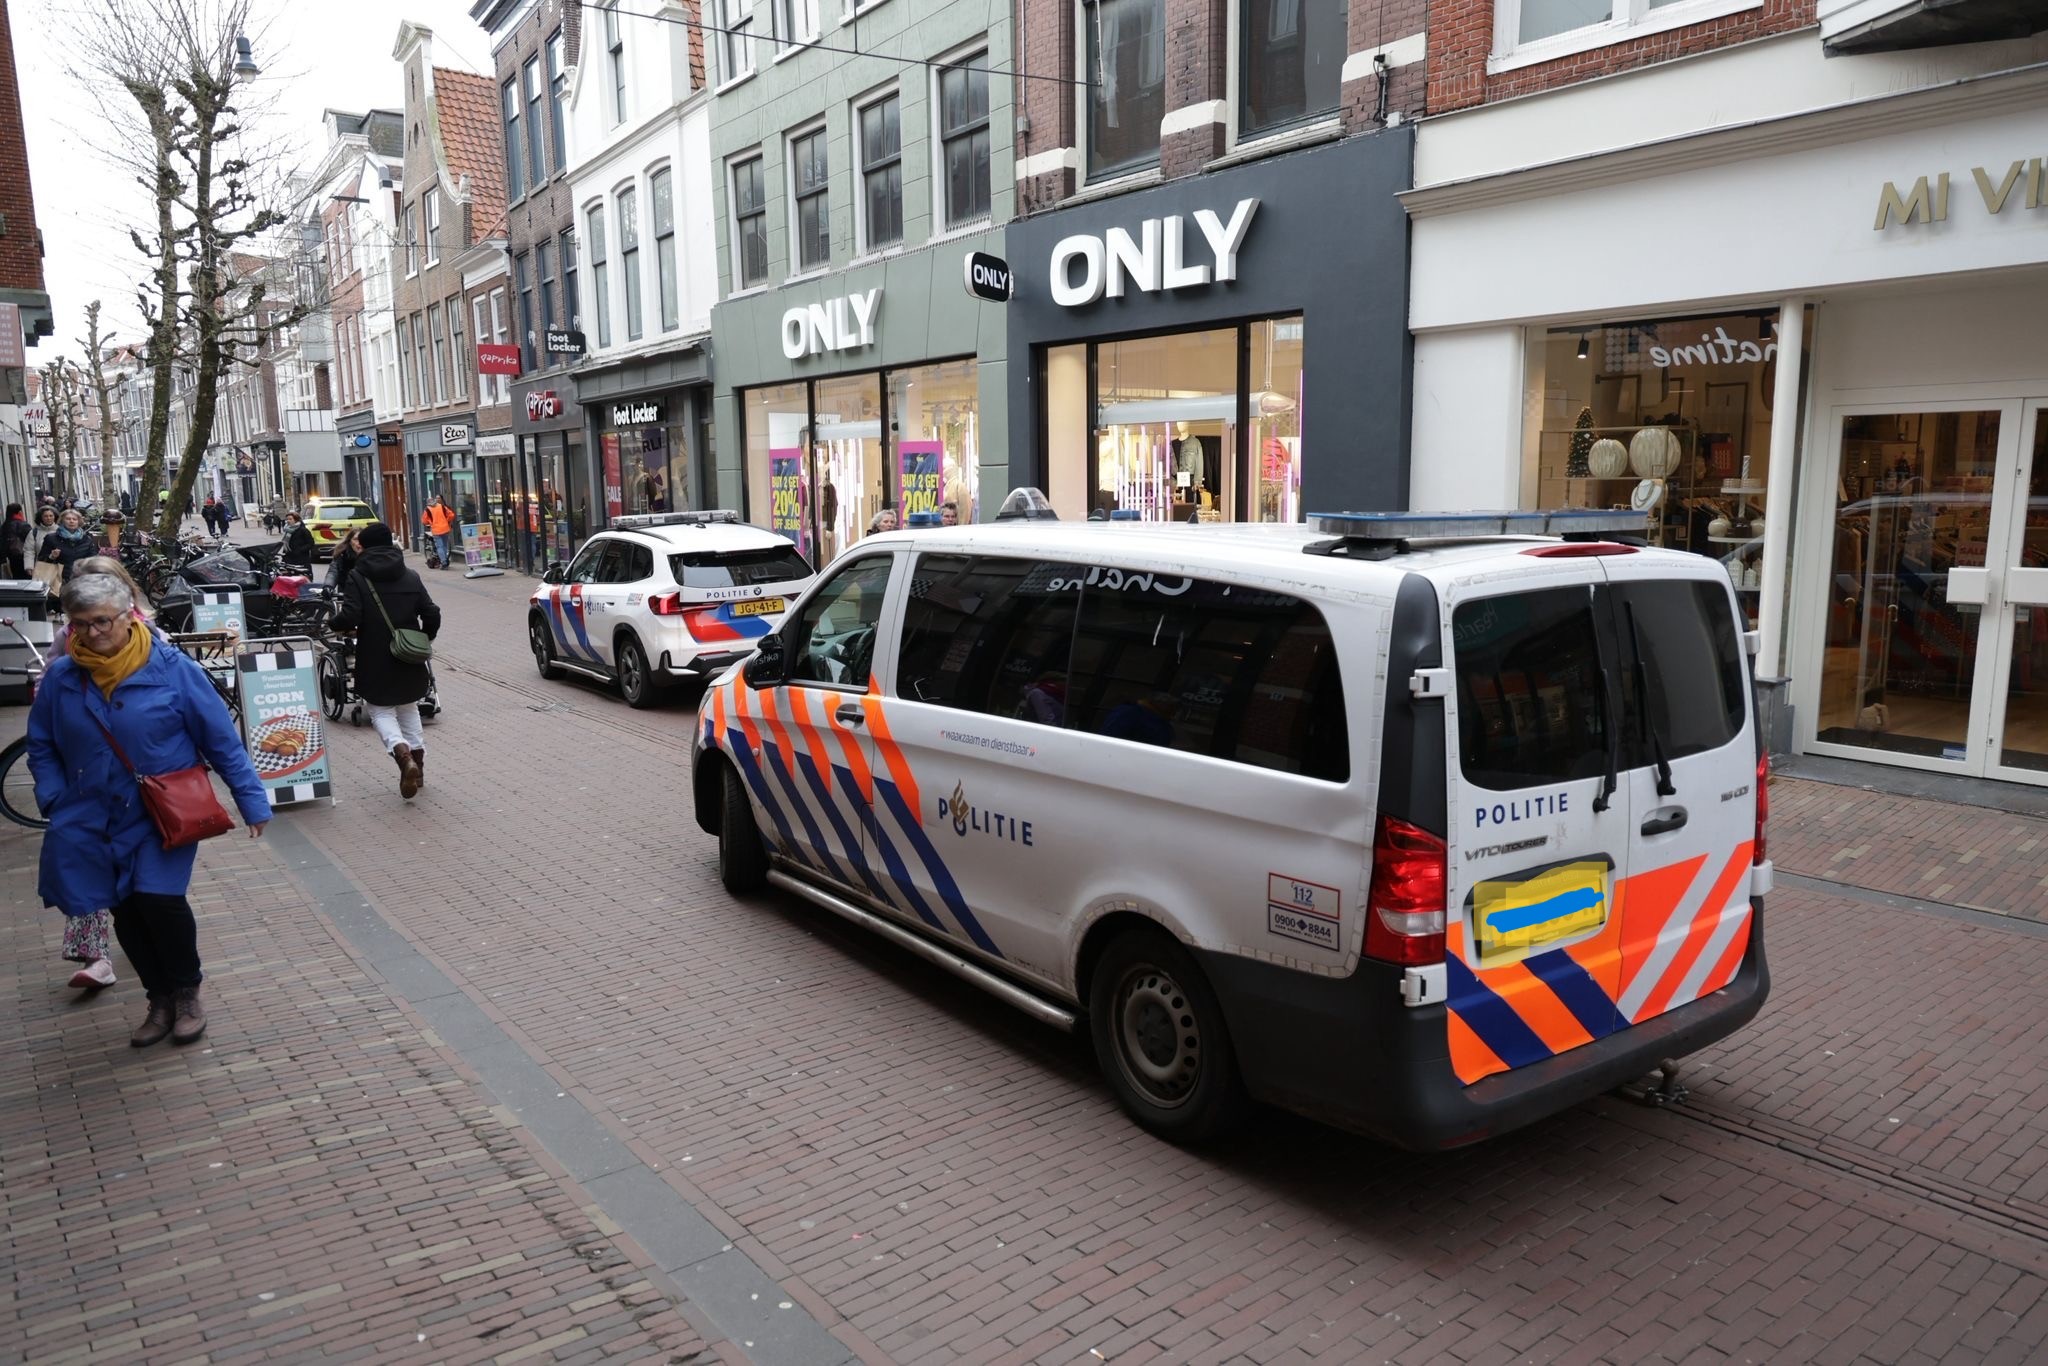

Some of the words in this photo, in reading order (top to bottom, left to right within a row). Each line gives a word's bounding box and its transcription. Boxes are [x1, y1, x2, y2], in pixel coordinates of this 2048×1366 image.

[1874, 172, 1950, 230] MI
[1971, 155, 2048, 214] VI
[1050, 198, 1261, 306] ONLY
[973, 264, 1008, 290] ONLY
[782, 288, 883, 359] ONLY
[547, 333, 568, 343] Foot
[548, 342, 581, 352] Locker
[613, 405, 630, 425] Foot
[631, 402, 658, 423] Locker
[444, 426, 467, 440] Etos
[772, 476, 782, 488] BUY
[788, 476, 799, 488] GET
[902, 474, 917, 487] BUY
[918, 474, 924, 489] 2
[925, 474, 940, 488] GET
[773, 489, 800, 516] 20%
[903, 489, 939, 520] 20%
[774, 518, 783, 530] OFF
[706, 589, 748, 599] POLITIE
[253, 690, 305, 705] CORN
[258, 704, 308, 719] DOGS
[302, 768, 323, 777] 5,50
[1476, 793, 1569, 828] POLITIE
[938, 797, 1033, 846] POLITIE
[1274, 913, 1296, 928] 0900
[1308, 922, 1331, 938] 8844
